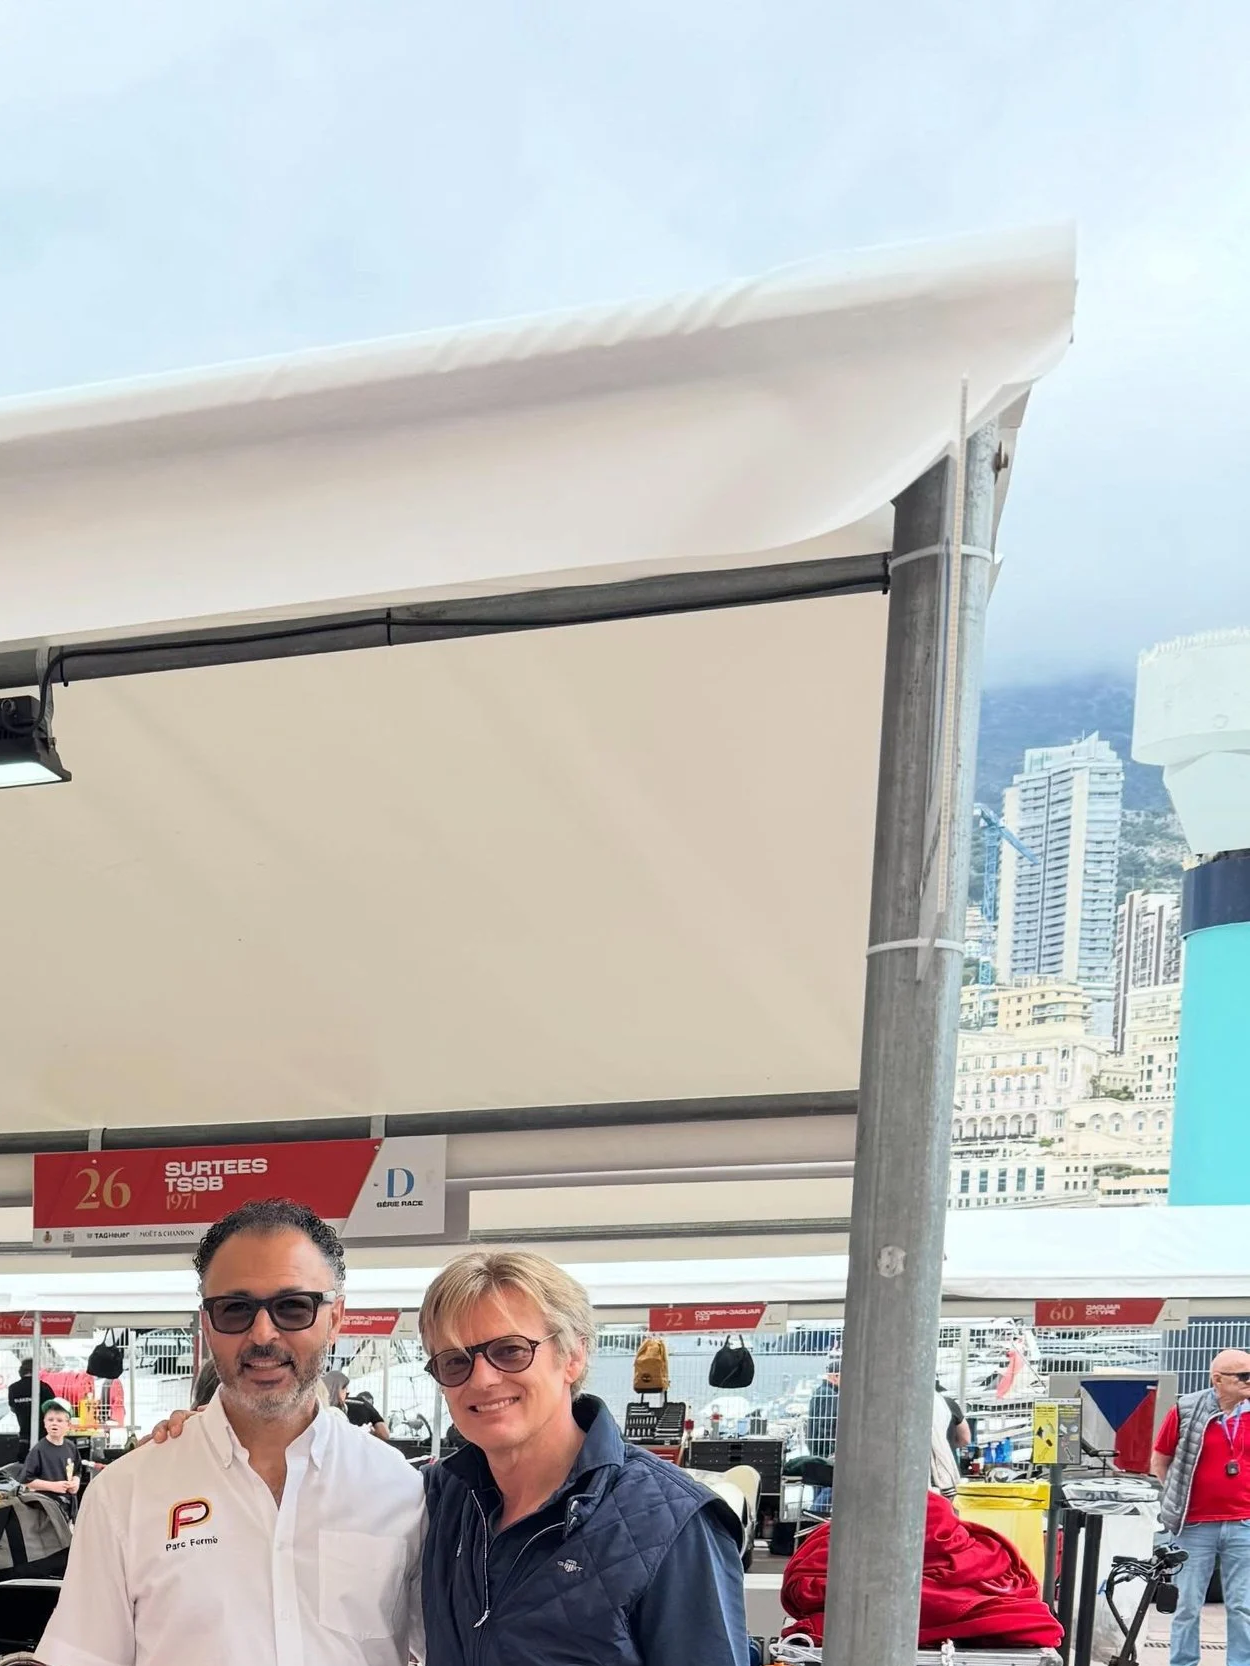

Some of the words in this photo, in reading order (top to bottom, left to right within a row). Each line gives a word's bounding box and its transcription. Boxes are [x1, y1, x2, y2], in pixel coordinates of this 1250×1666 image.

[165, 1158, 268, 1177] SURTEES
[75, 1166, 132, 1211] 26
[165, 1176, 224, 1194] TS9B
[387, 1168, 415, 1198] D
[165, 1192, 197, 1211] 1971
[663, 1312, 684, 1327] 72
[694, 1308, 761, 1317] COOPER-JAGUAR
[1049, 1305, 1075, 1321] 60
[165, 1542, 187, 1552] Parc
